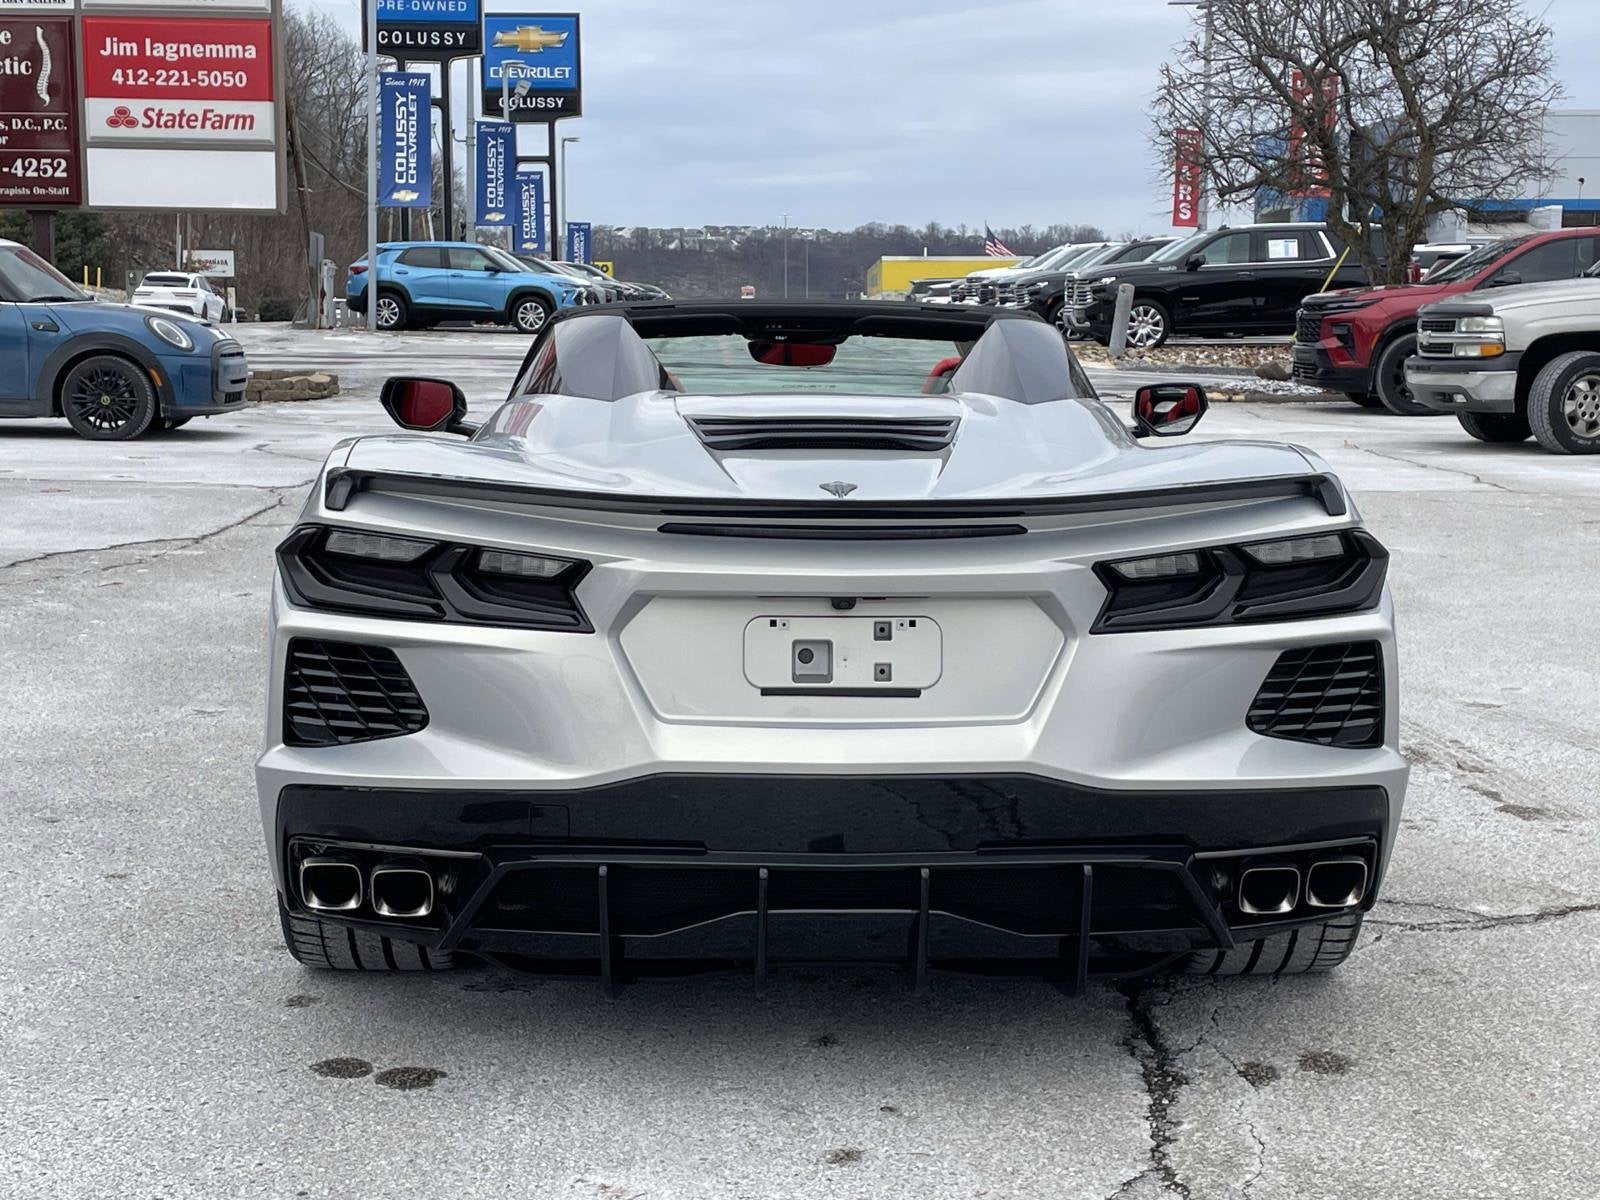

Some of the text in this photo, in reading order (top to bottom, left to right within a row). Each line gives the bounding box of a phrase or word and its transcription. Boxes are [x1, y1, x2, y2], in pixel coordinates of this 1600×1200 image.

[377, 0, 467, 11] PRE-OWNED
[378, 30, 466, 45] COLUSSY
[100, 37, 257, 61] Jim Iagnemma
[112, 68, 248, 88] 412-221-5050
[385, 77, 426, 87] Since 1918
[489, 66, 573, 79] CHEVROLET
[395, 92, 407, 184] COLUSSY
[408, 92, 417, 184] CHEVROLET
[487, 136, 497, 208] COLUSSY
[497, 137, 505, 208] CHEVROLET
[33, 186, 70, 195] On-Staff
[521, 183, 530, 239] COLUSSY
